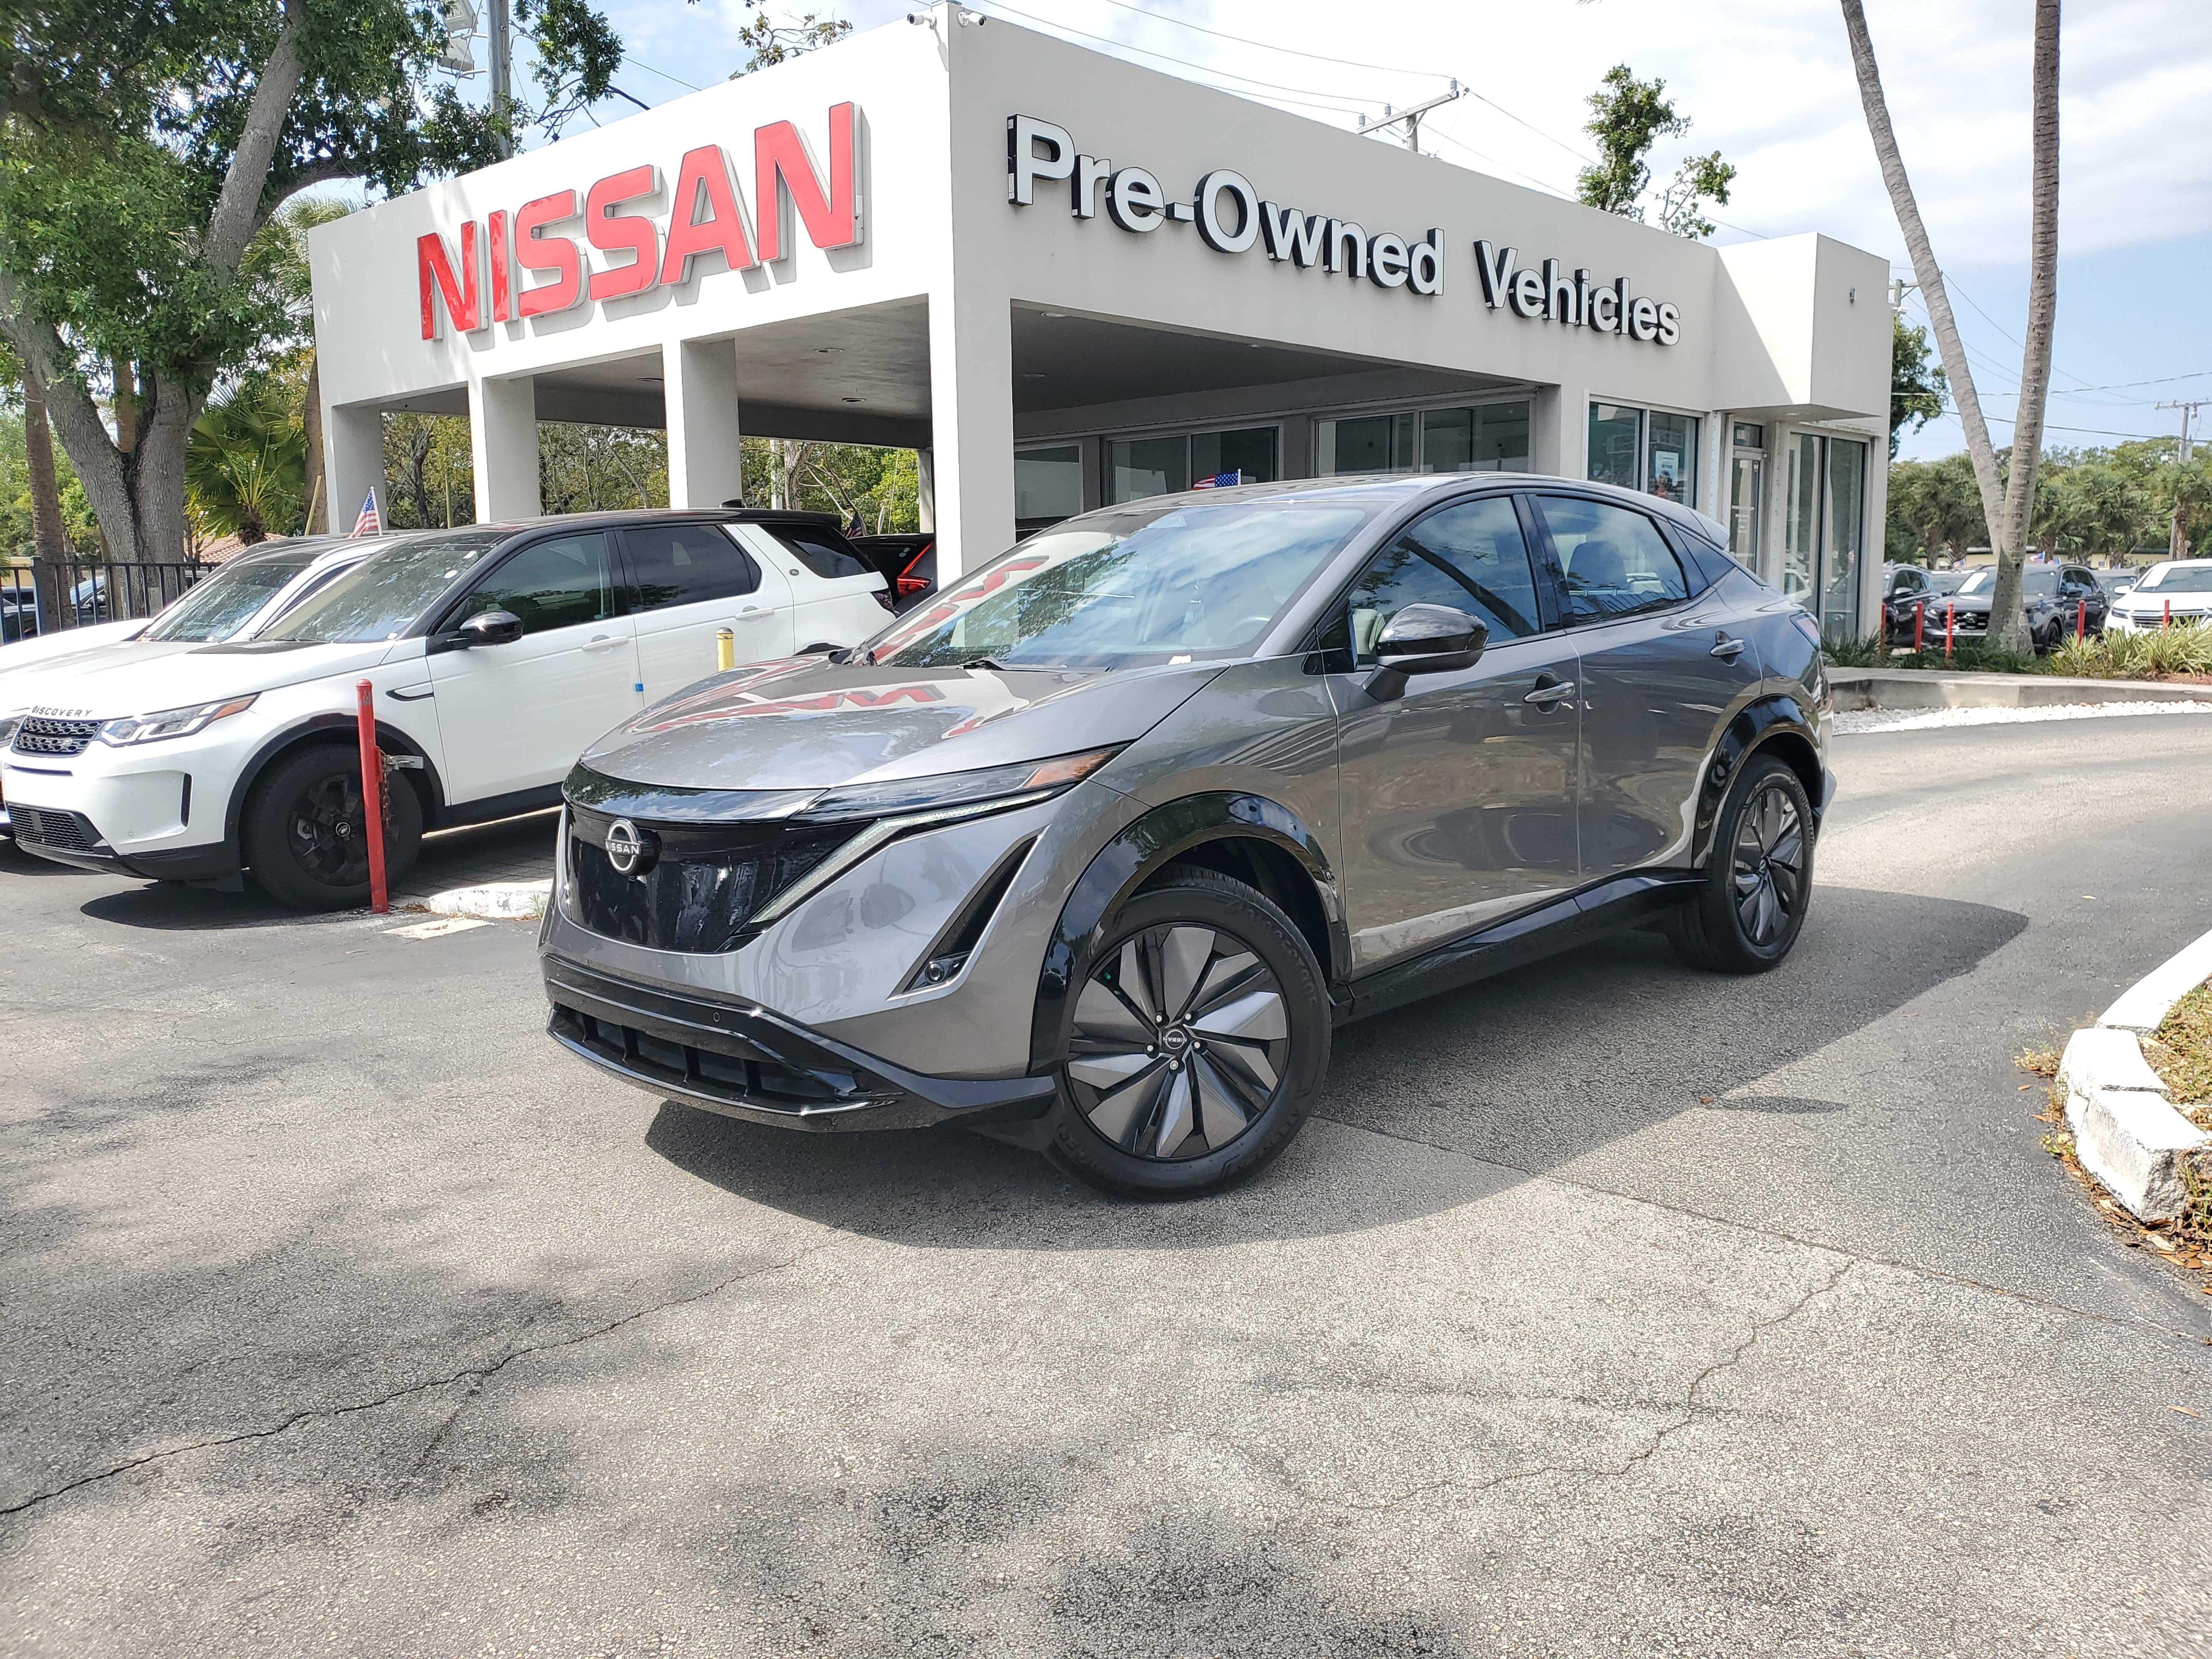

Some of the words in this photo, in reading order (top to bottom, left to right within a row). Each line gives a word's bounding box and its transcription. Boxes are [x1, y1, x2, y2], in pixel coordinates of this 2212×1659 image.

[417, 101, 860, 340] NISSAN
[1007, 114, 1445, 296] Pre-Owned
[1474, 240, 1680, 345] Vehicles
[32, 706, 93, 717] DISCOVERY
[605, 839, 639, 854] NISSAN
